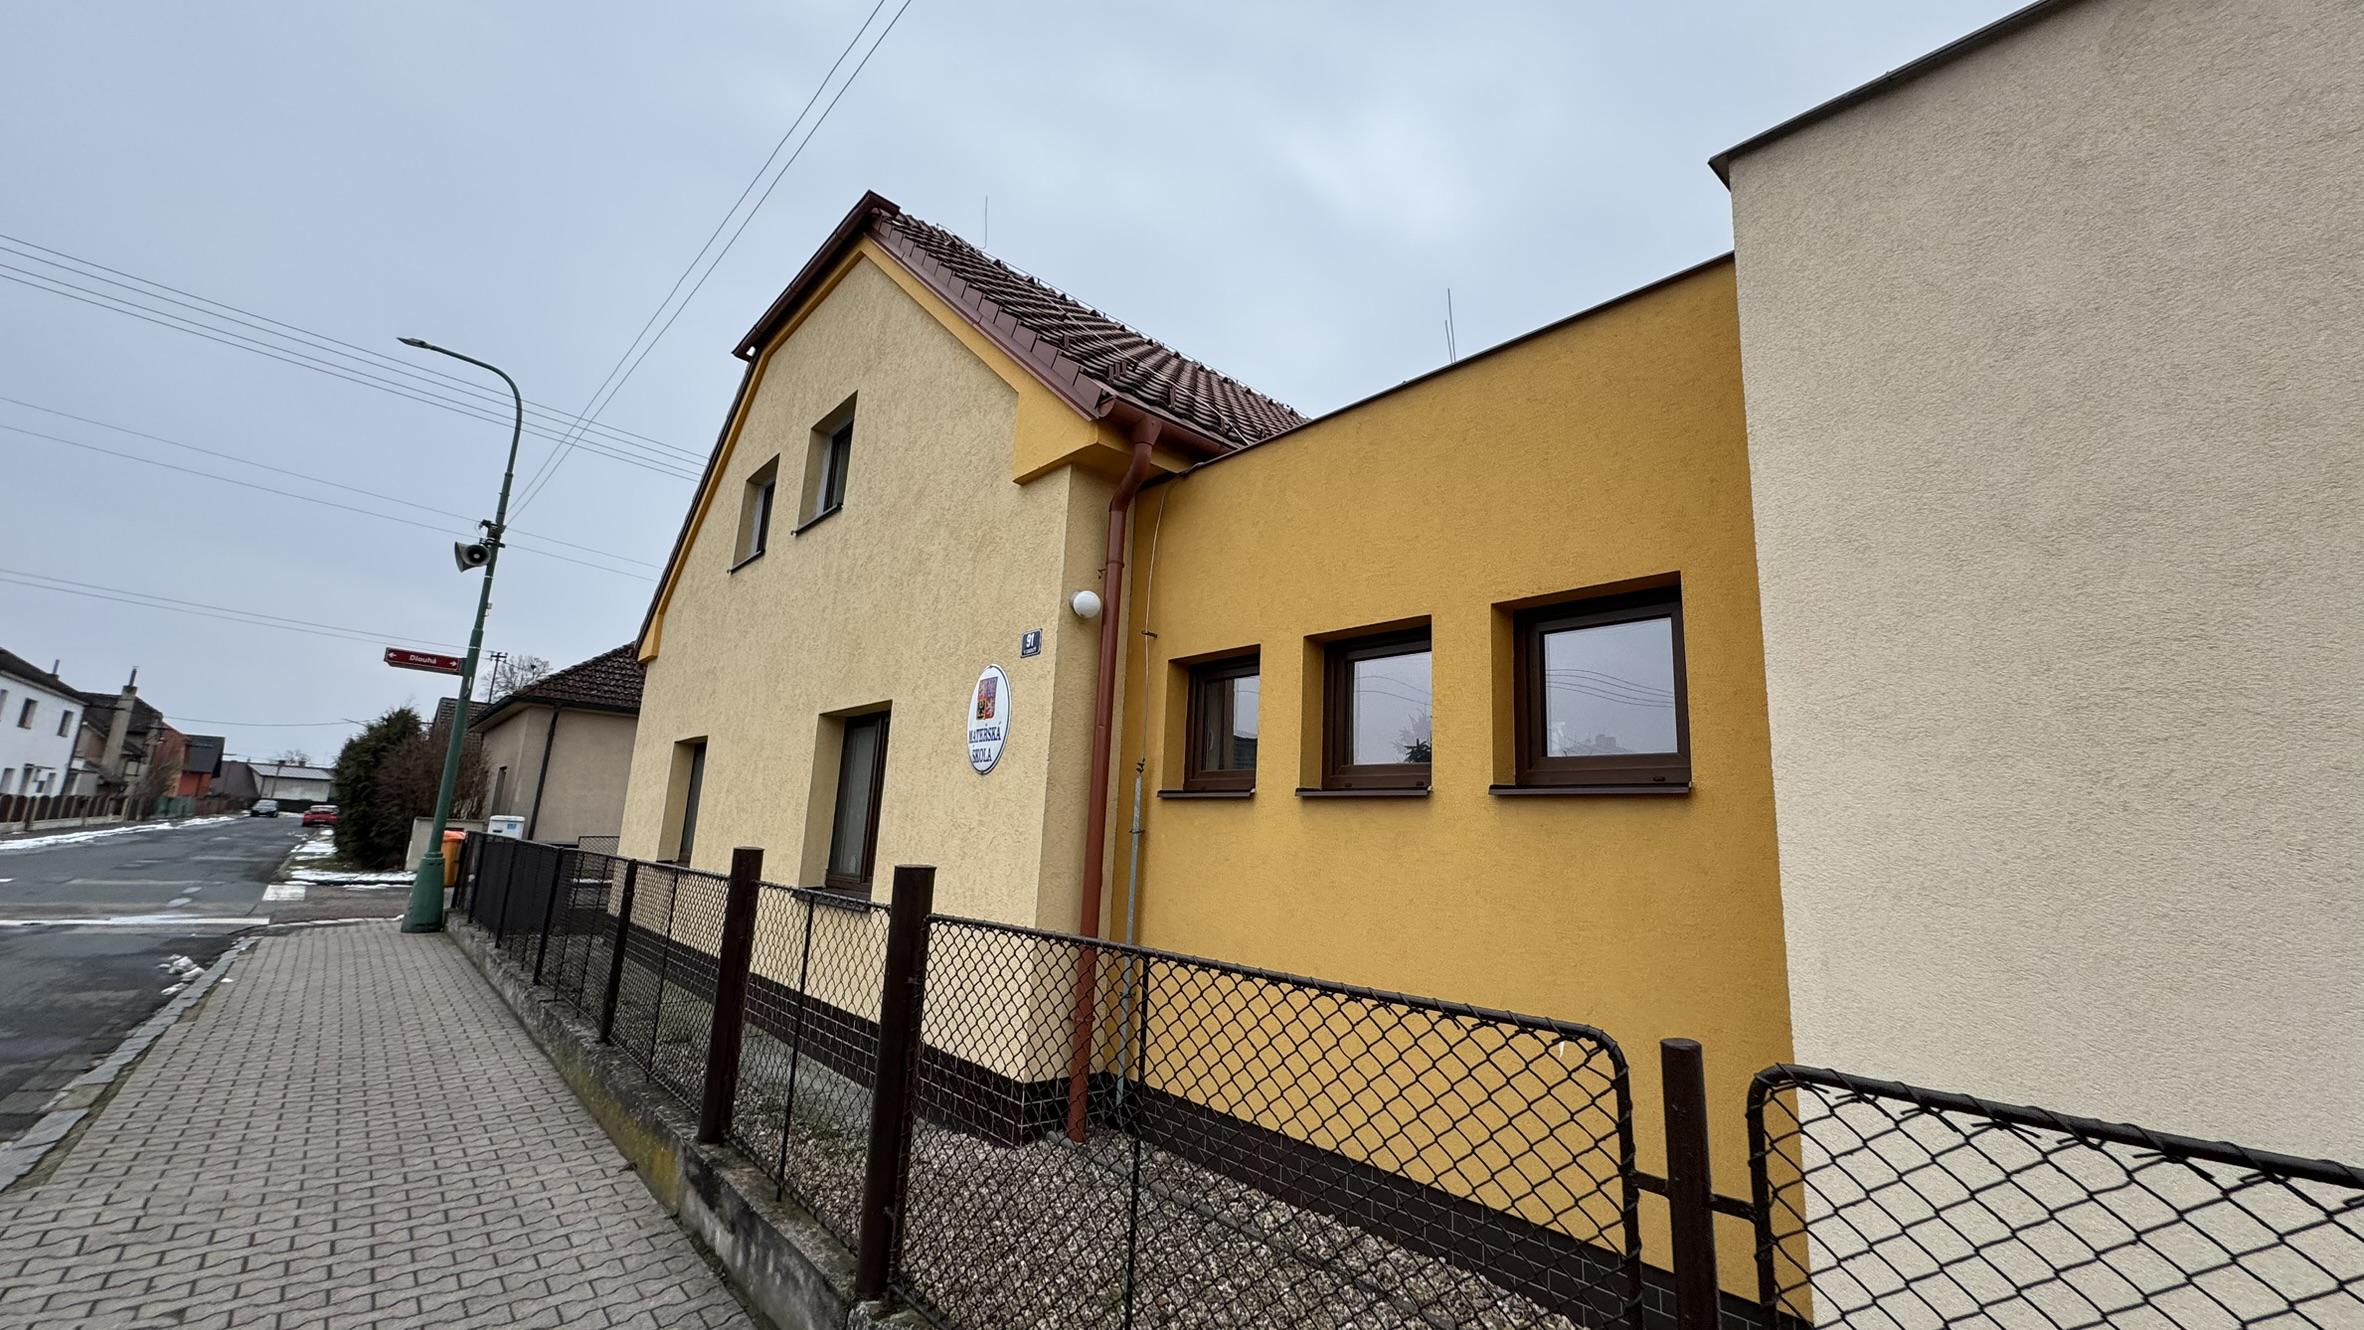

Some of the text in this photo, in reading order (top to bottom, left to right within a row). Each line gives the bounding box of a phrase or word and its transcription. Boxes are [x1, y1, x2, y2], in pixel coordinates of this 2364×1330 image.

[1026, 632, 1035, 648] 91
[409, 654, 437, 664] Dlouhá
[968, 721, 1001, 744] MATEŘSKÁ
[972, 745, 992, 763] ŠKOLA
